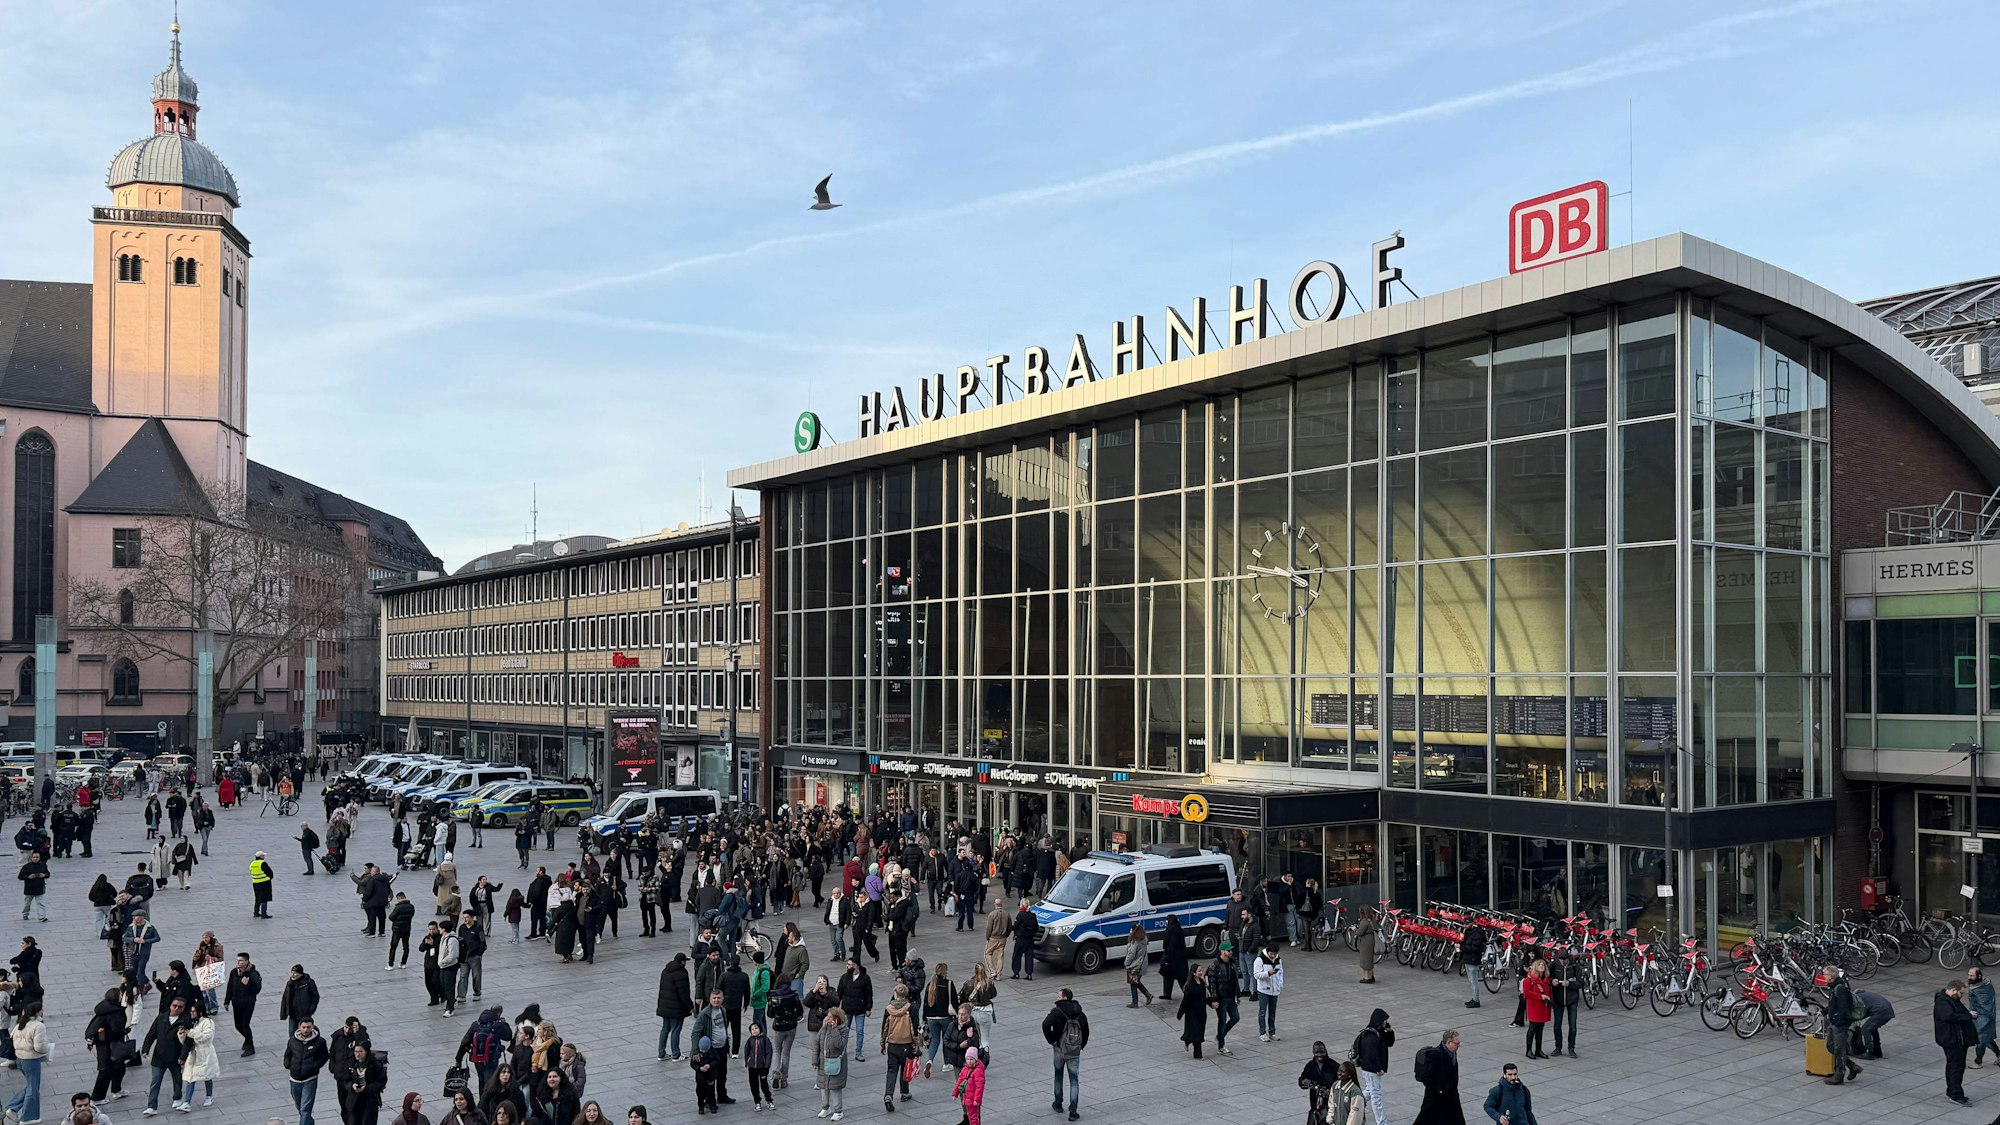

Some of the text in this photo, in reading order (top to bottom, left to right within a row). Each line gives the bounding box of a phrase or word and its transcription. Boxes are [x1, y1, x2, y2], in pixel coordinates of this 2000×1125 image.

[1521, 197, 1592, 264] DB
[858, 236, 1406, 438] HAUPTBAHNHOF
[798, 417, 812, 450] S
[1879, 559, 1975, 580] HERMÈS
[807, 756, 838, 766] THE BODY SHOP
[880, 760, 973, 778] NetCologne Highspeed
[991, 768, 1039, 784] NetCologne
[1132, 793, 1181, 818] Kamps
